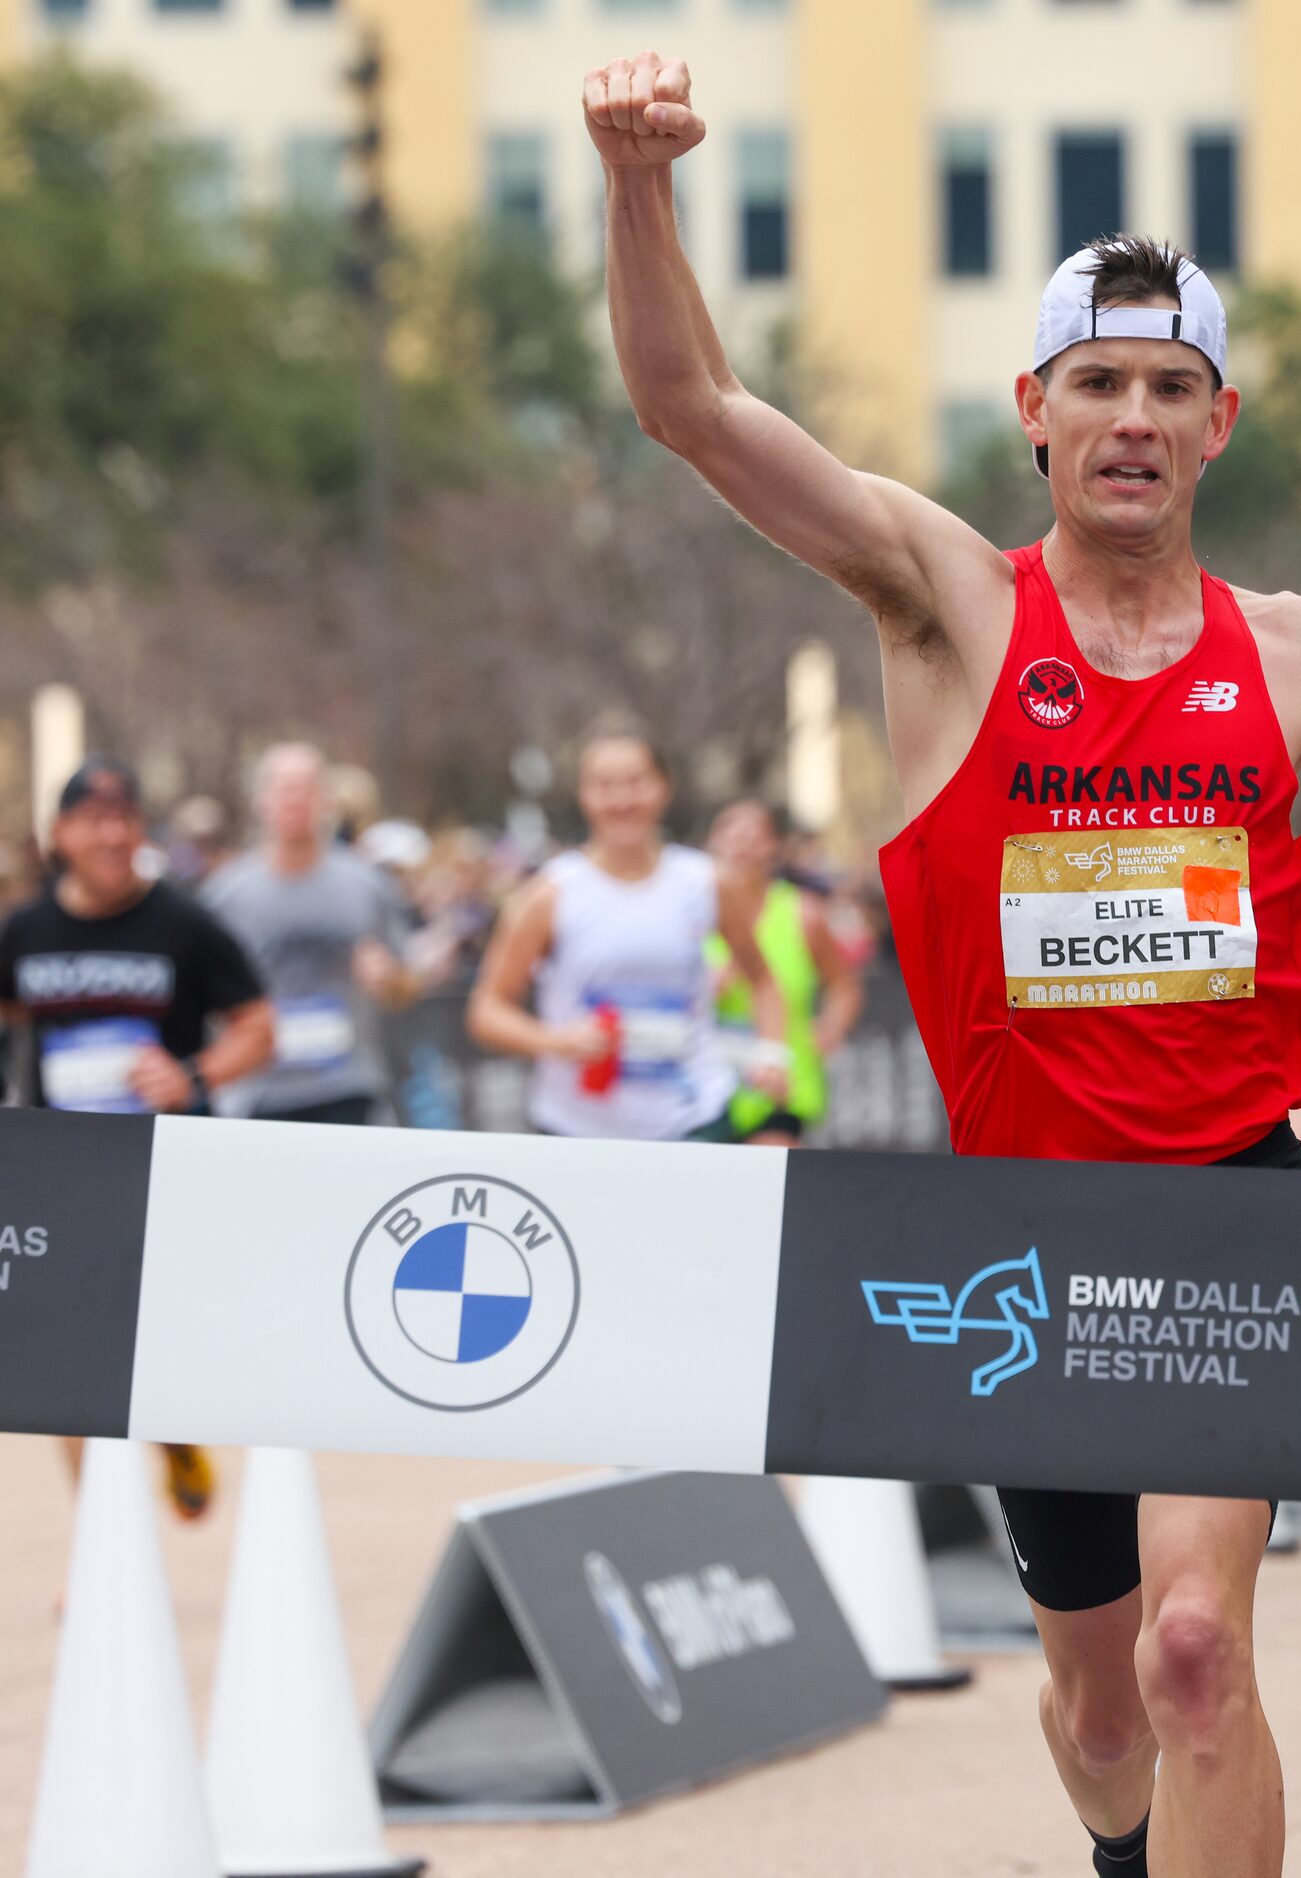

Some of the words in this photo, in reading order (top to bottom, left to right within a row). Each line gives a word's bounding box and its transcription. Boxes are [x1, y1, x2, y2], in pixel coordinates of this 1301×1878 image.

[1029, 709, 1051, 725] TRACK
[1053, 715, 1071, 726] CLUB
[1008, 761, 1262, 804] ARKANSAS
[1050, 808, 1138, 827] TRACK
[1150, 806, 1216, 825] CLUB
[1117, 847, 1142, 856] BMW
[1144, 845, 1185, 855] DALLAS
[1117, 855, 1177, 866] MARATHON
[1118, 866, 1168, 875] FESTIVAL
[1095, 898, 1164, 920] ELITE
[1040, 930, 1224, 967] BECKETT
[1027, 981, 1157, 1003] MARATHON
[383, 1186, 553, 1252] BMW
[1068, 1274, 1165, 1310] BMW
[1066, 1312, 1290, 1352] MARATHON
[1064, 1347, 1249, 1386] FESTIVAL
